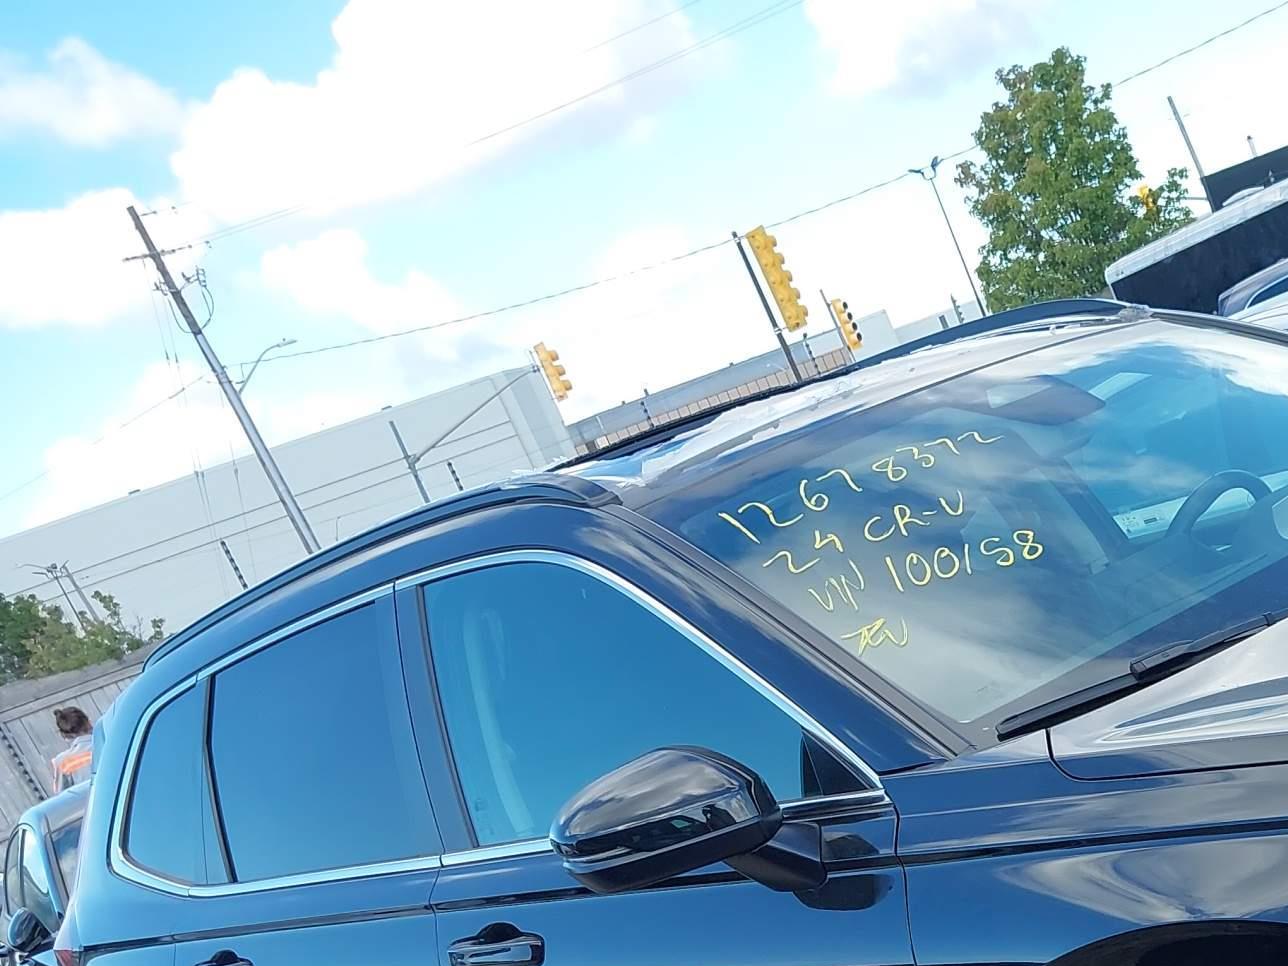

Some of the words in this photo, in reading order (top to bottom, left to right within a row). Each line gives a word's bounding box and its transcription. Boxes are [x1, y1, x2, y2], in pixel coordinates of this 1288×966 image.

[763, 530, 844, 574] 24
[863, 490, 966, 542] CR-V
[808, 560, 865, 612] VIN
[884, 530, 1045, 592] 100158
